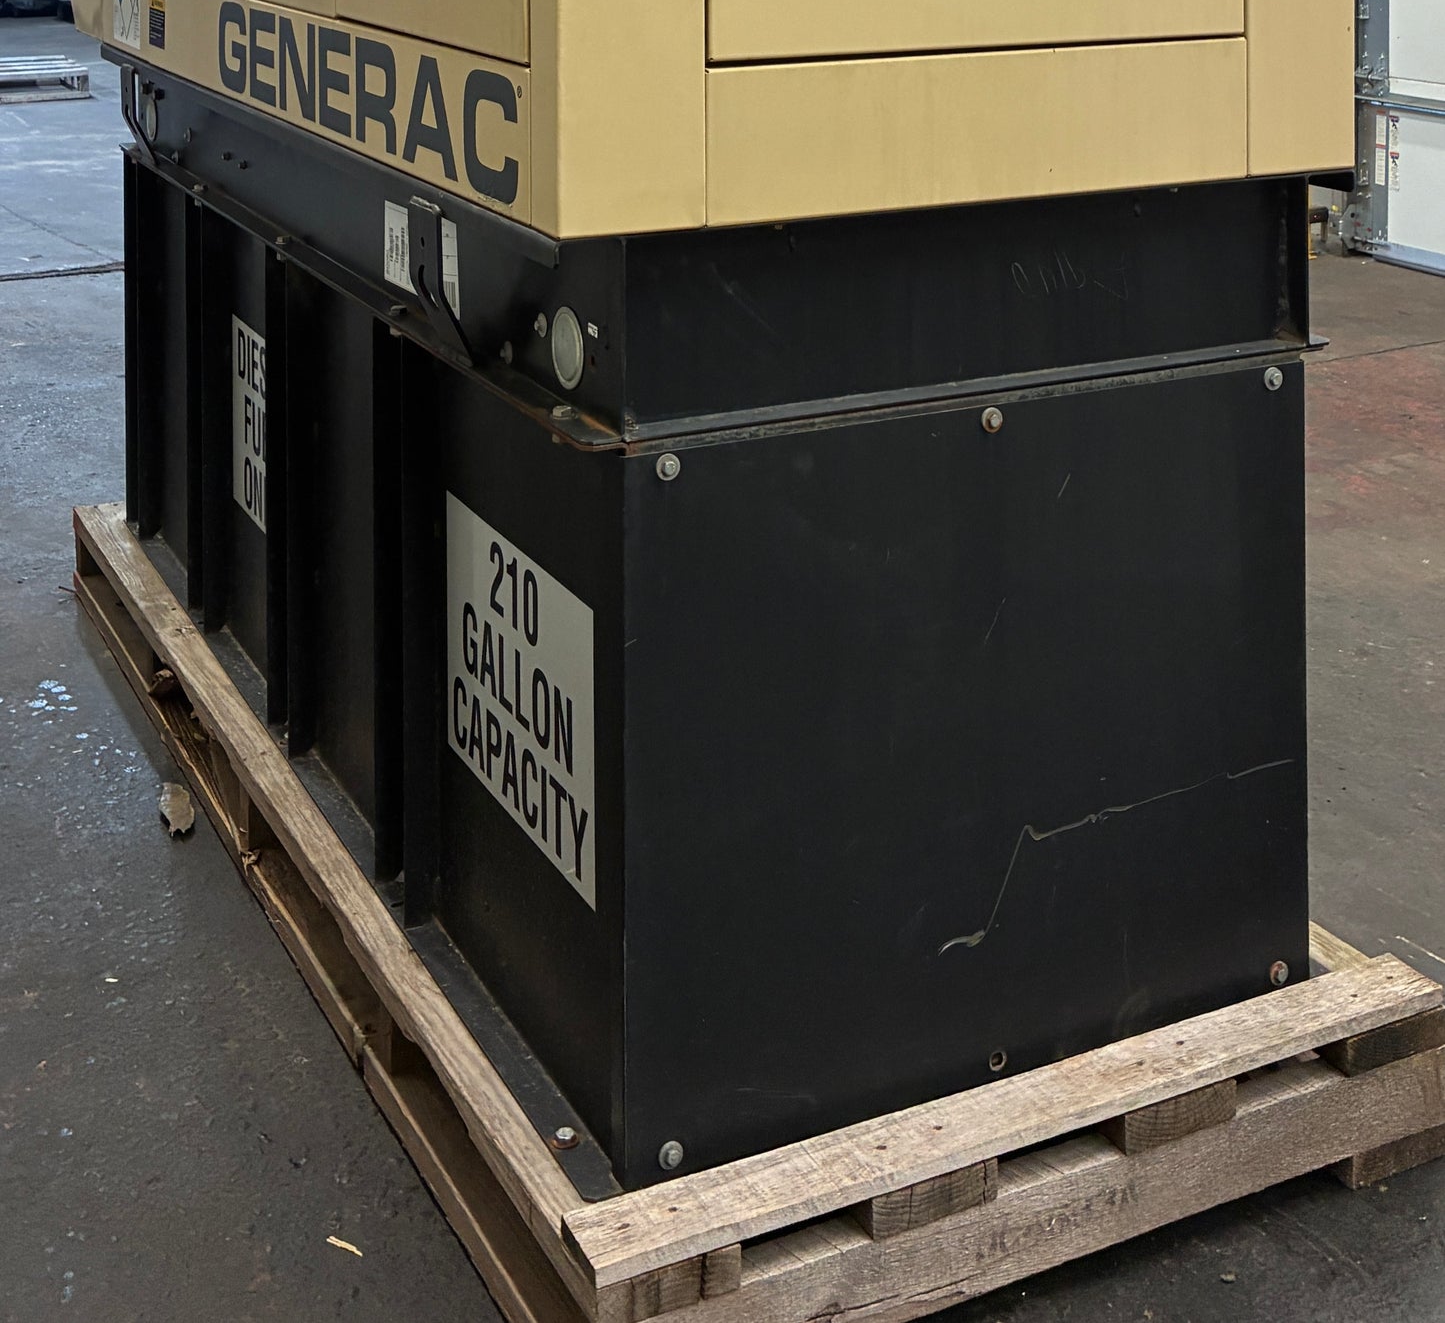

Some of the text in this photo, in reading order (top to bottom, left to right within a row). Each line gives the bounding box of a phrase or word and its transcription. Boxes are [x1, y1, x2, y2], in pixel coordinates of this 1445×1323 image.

[218, 1, 519, 204] GENERAC
[244, 455, 265, 522] ON
[489, 541, 538, 647] 210
[462, 602, 574, 777] GALLON
[453, 676, 588, 883] CAPACITY
